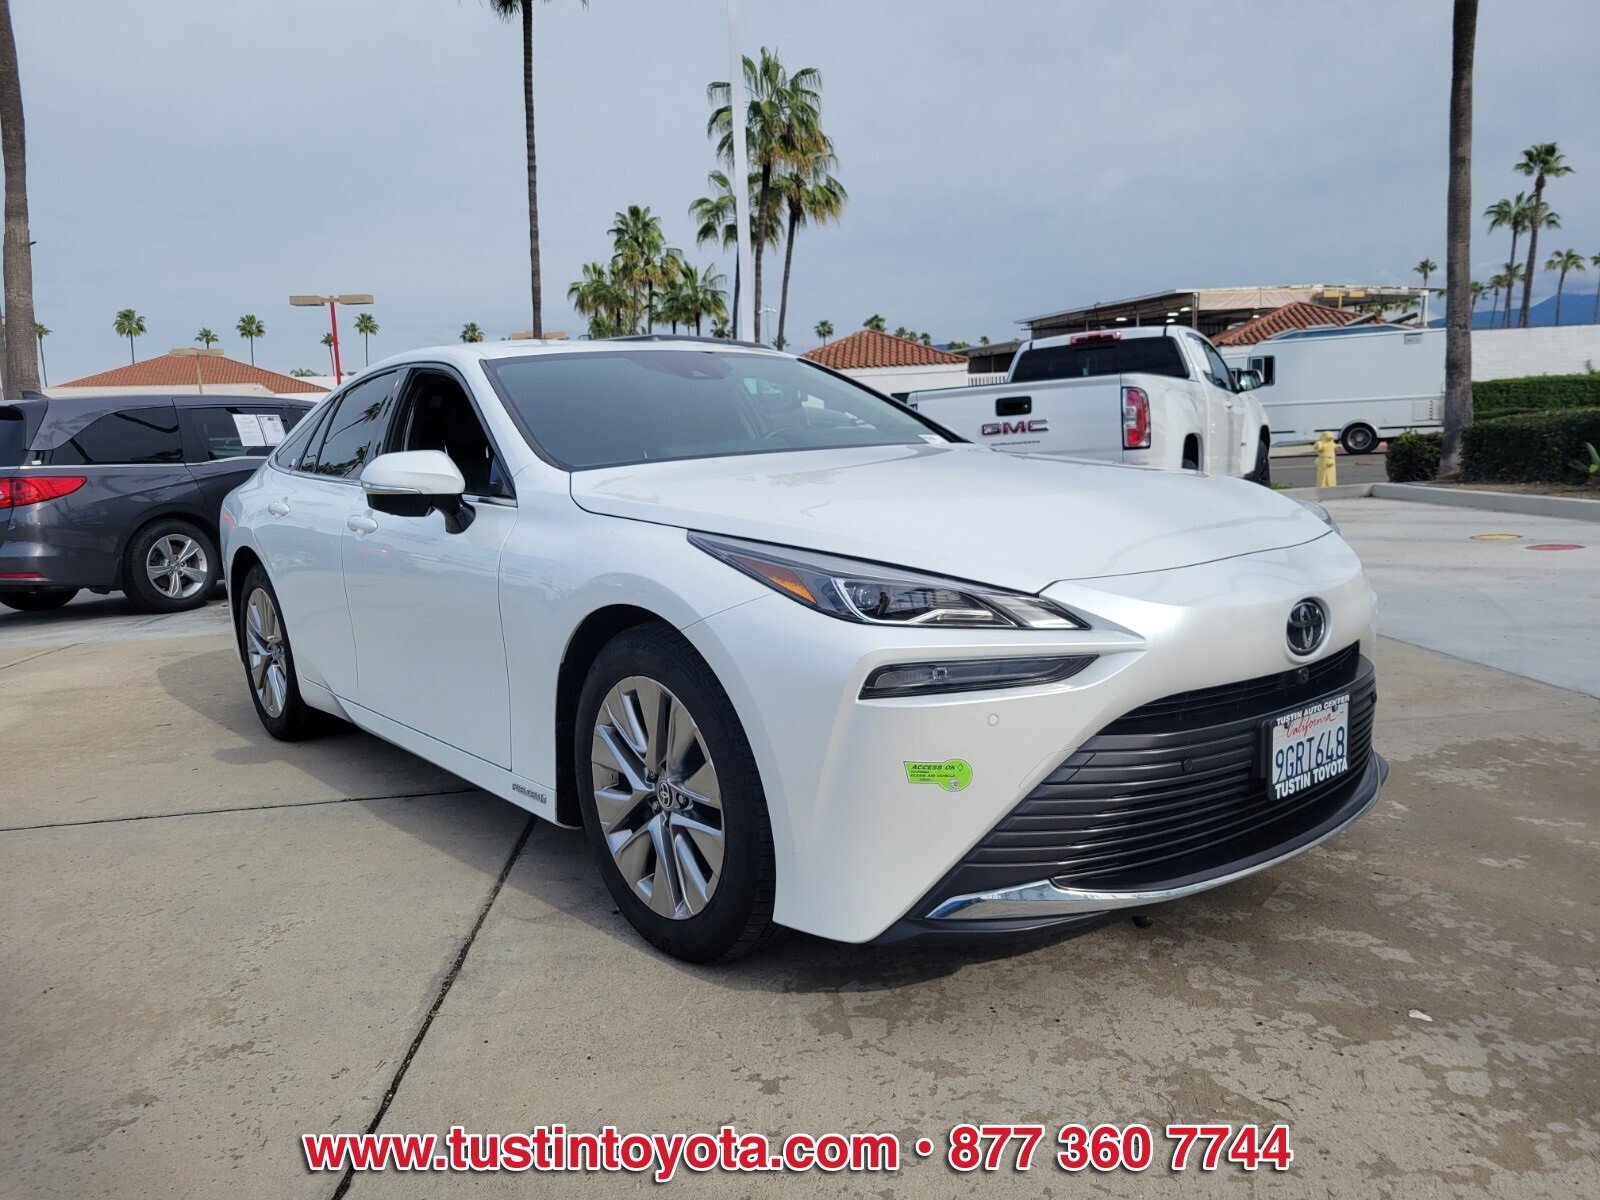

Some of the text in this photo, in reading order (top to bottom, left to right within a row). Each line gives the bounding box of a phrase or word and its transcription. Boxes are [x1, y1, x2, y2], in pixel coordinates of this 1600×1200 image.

[982, 418, 1049, 435] GMC
[1276, 695, 1350, 726] TUSTIN AUTO CENTER
[1286, 712, 1336, 738] California
[1275, 725, 1345, 784] 9GRT648
[1275, 757, 1348, 799] TUSTIN TOYOTA
